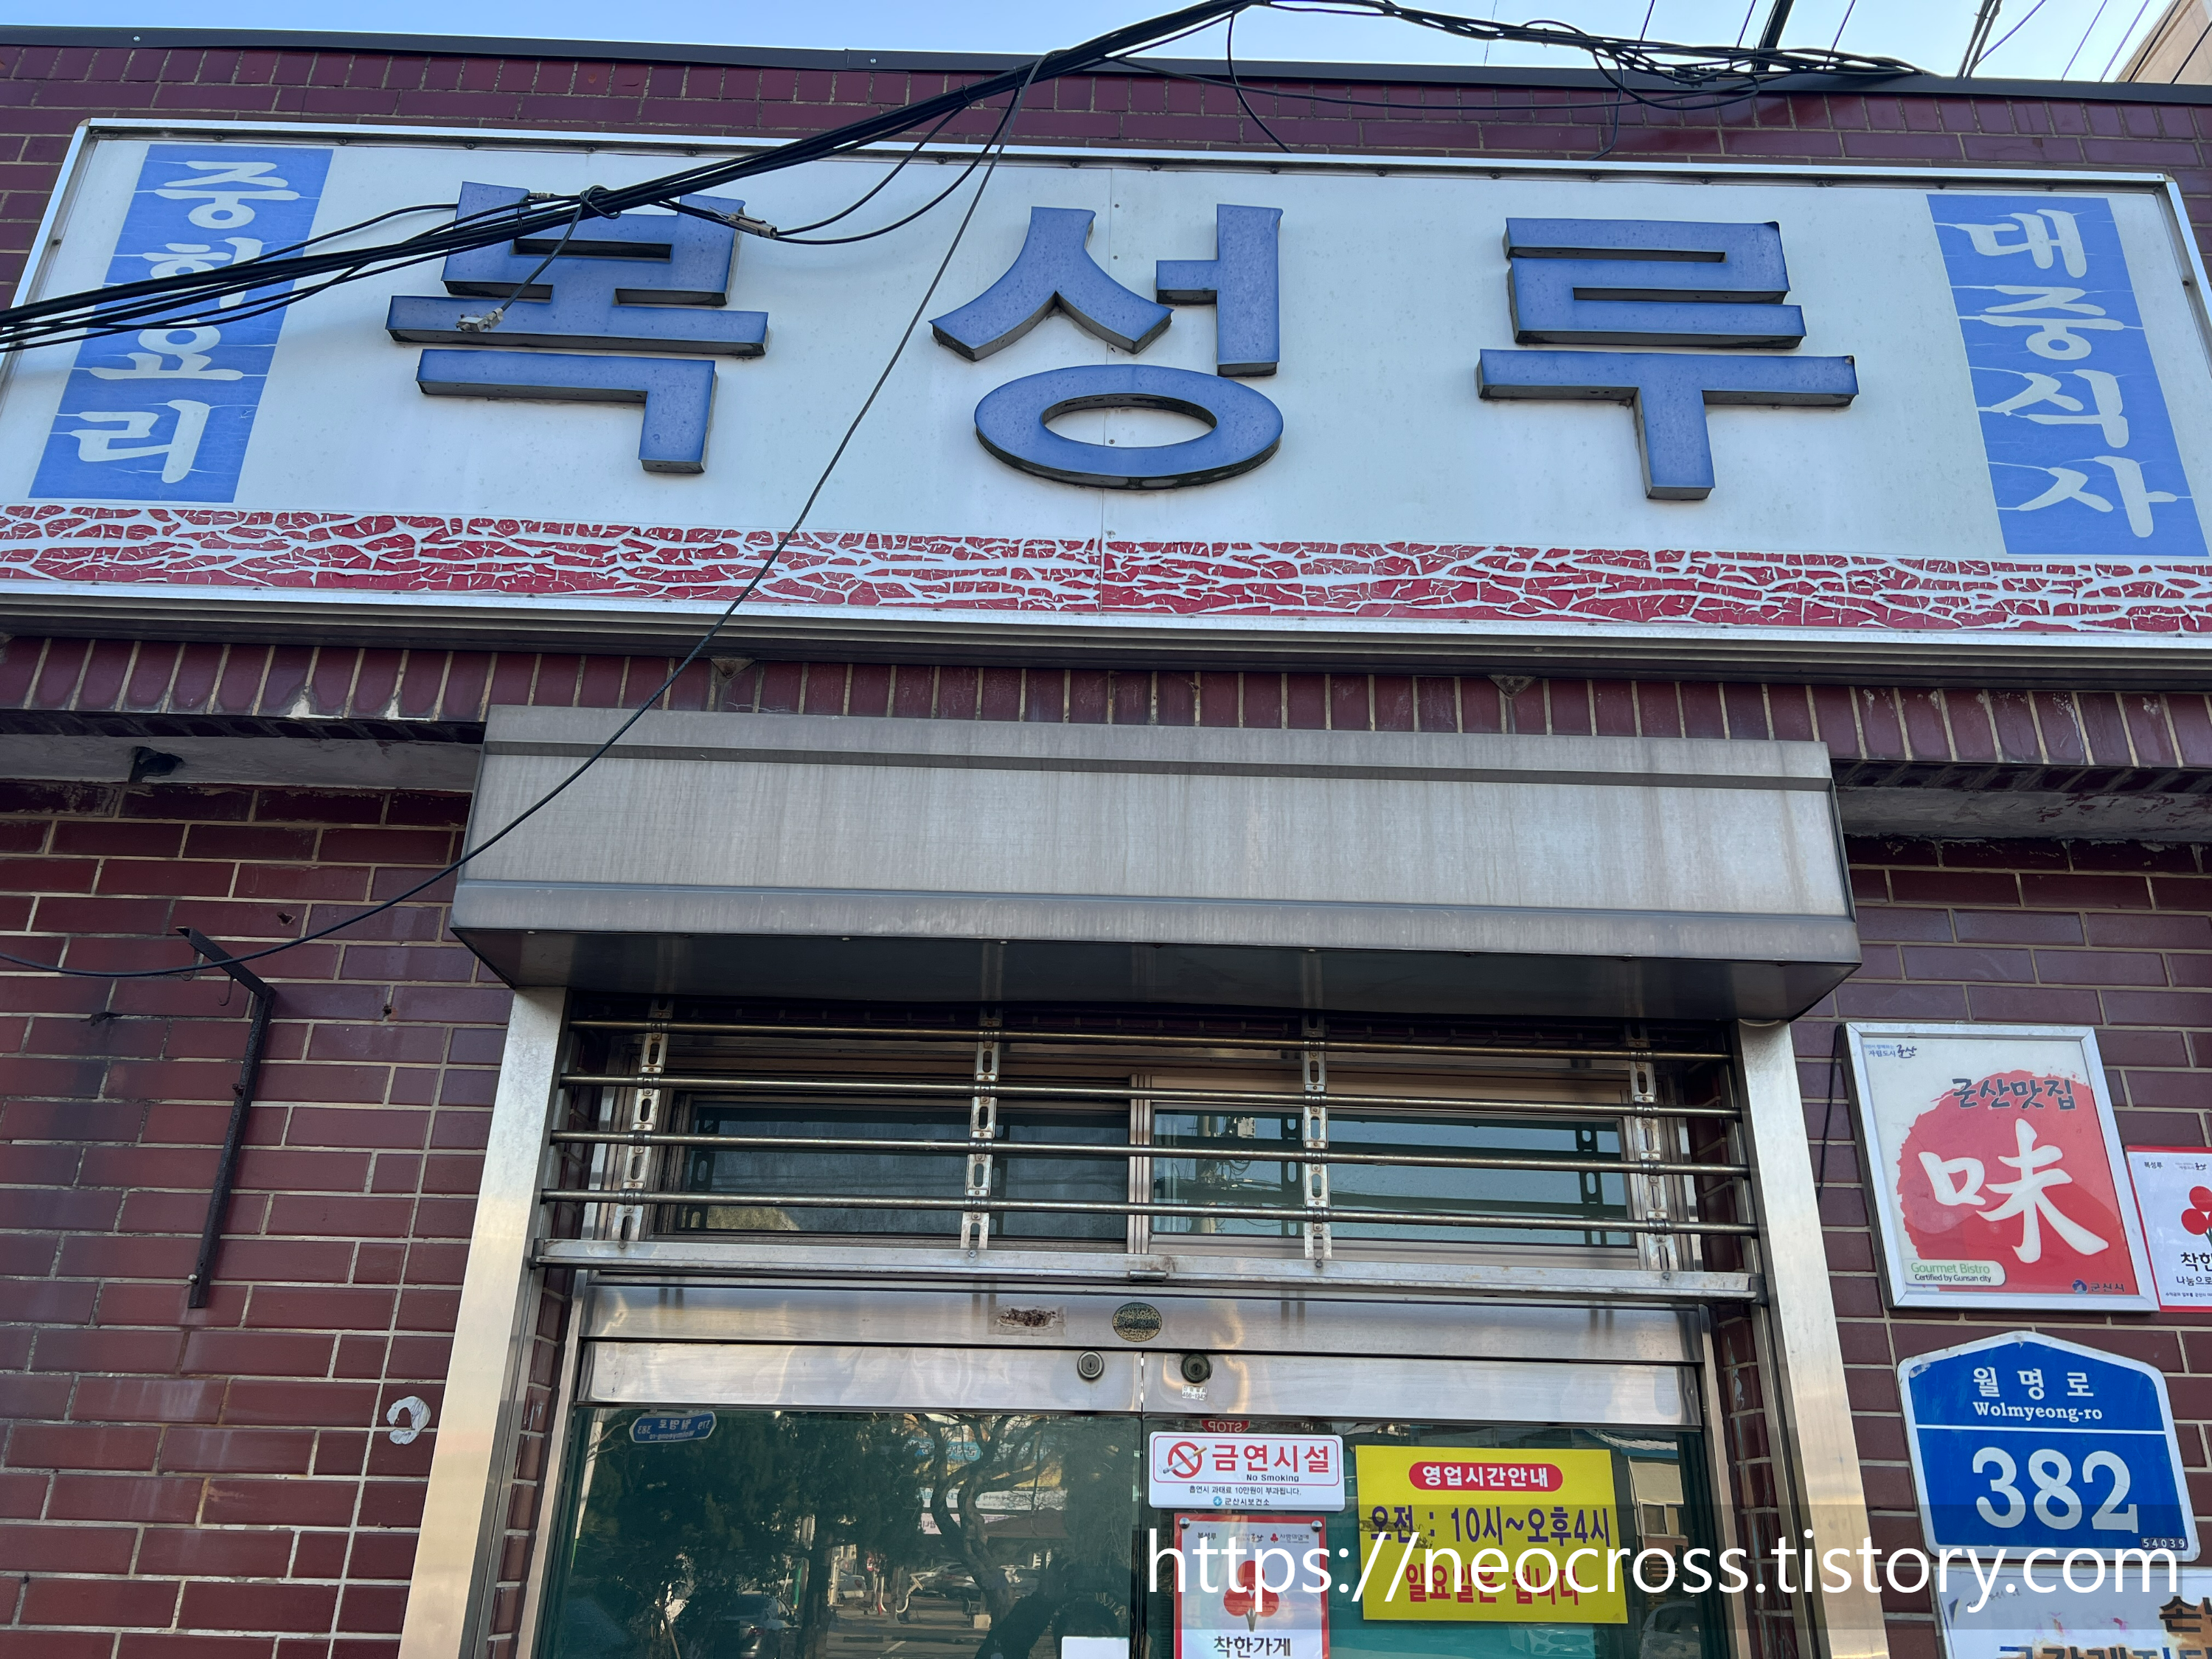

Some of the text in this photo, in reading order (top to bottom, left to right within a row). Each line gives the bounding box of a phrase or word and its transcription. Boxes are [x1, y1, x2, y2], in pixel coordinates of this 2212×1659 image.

[1955, 209, 2178, 538] 대중식사
[1952, 1078, 2077, 1110] 군산맛집
[1918, 1118, 2110, 1264] 味
[1910, 1262, 1990, 1275] Gourmet Bistro
[1915, 1274, 1942, 1282] Certified
[1944, 1274, 1952, 1282] by
[1979, 1275, 1992, 1283] city
[1973, 1366, 2094, 1400] 월명로
[1972, 1402, 2103, 1423] Wolmyeong-ro
[1211, 1444, 1329, 1473] 금연시설
[1261, 1474, 1300, 1484] Smoking
[1422, 1465, 1549, 1488] 영업시간안내
[1189, 1485, 1302, 1496] 흡연시 과태료 10만원이 부과됩니다.
[1972, 1447, 2139, 1534] 382
[1225, 1498, 1270, 1507] 군산시보건소
[1450, 1506, 1611, 1547] 10시~오후4시
[2142, 1538, 2185, 1548] 54039
[1214, 1636, 1291, 1658] 착한가게
